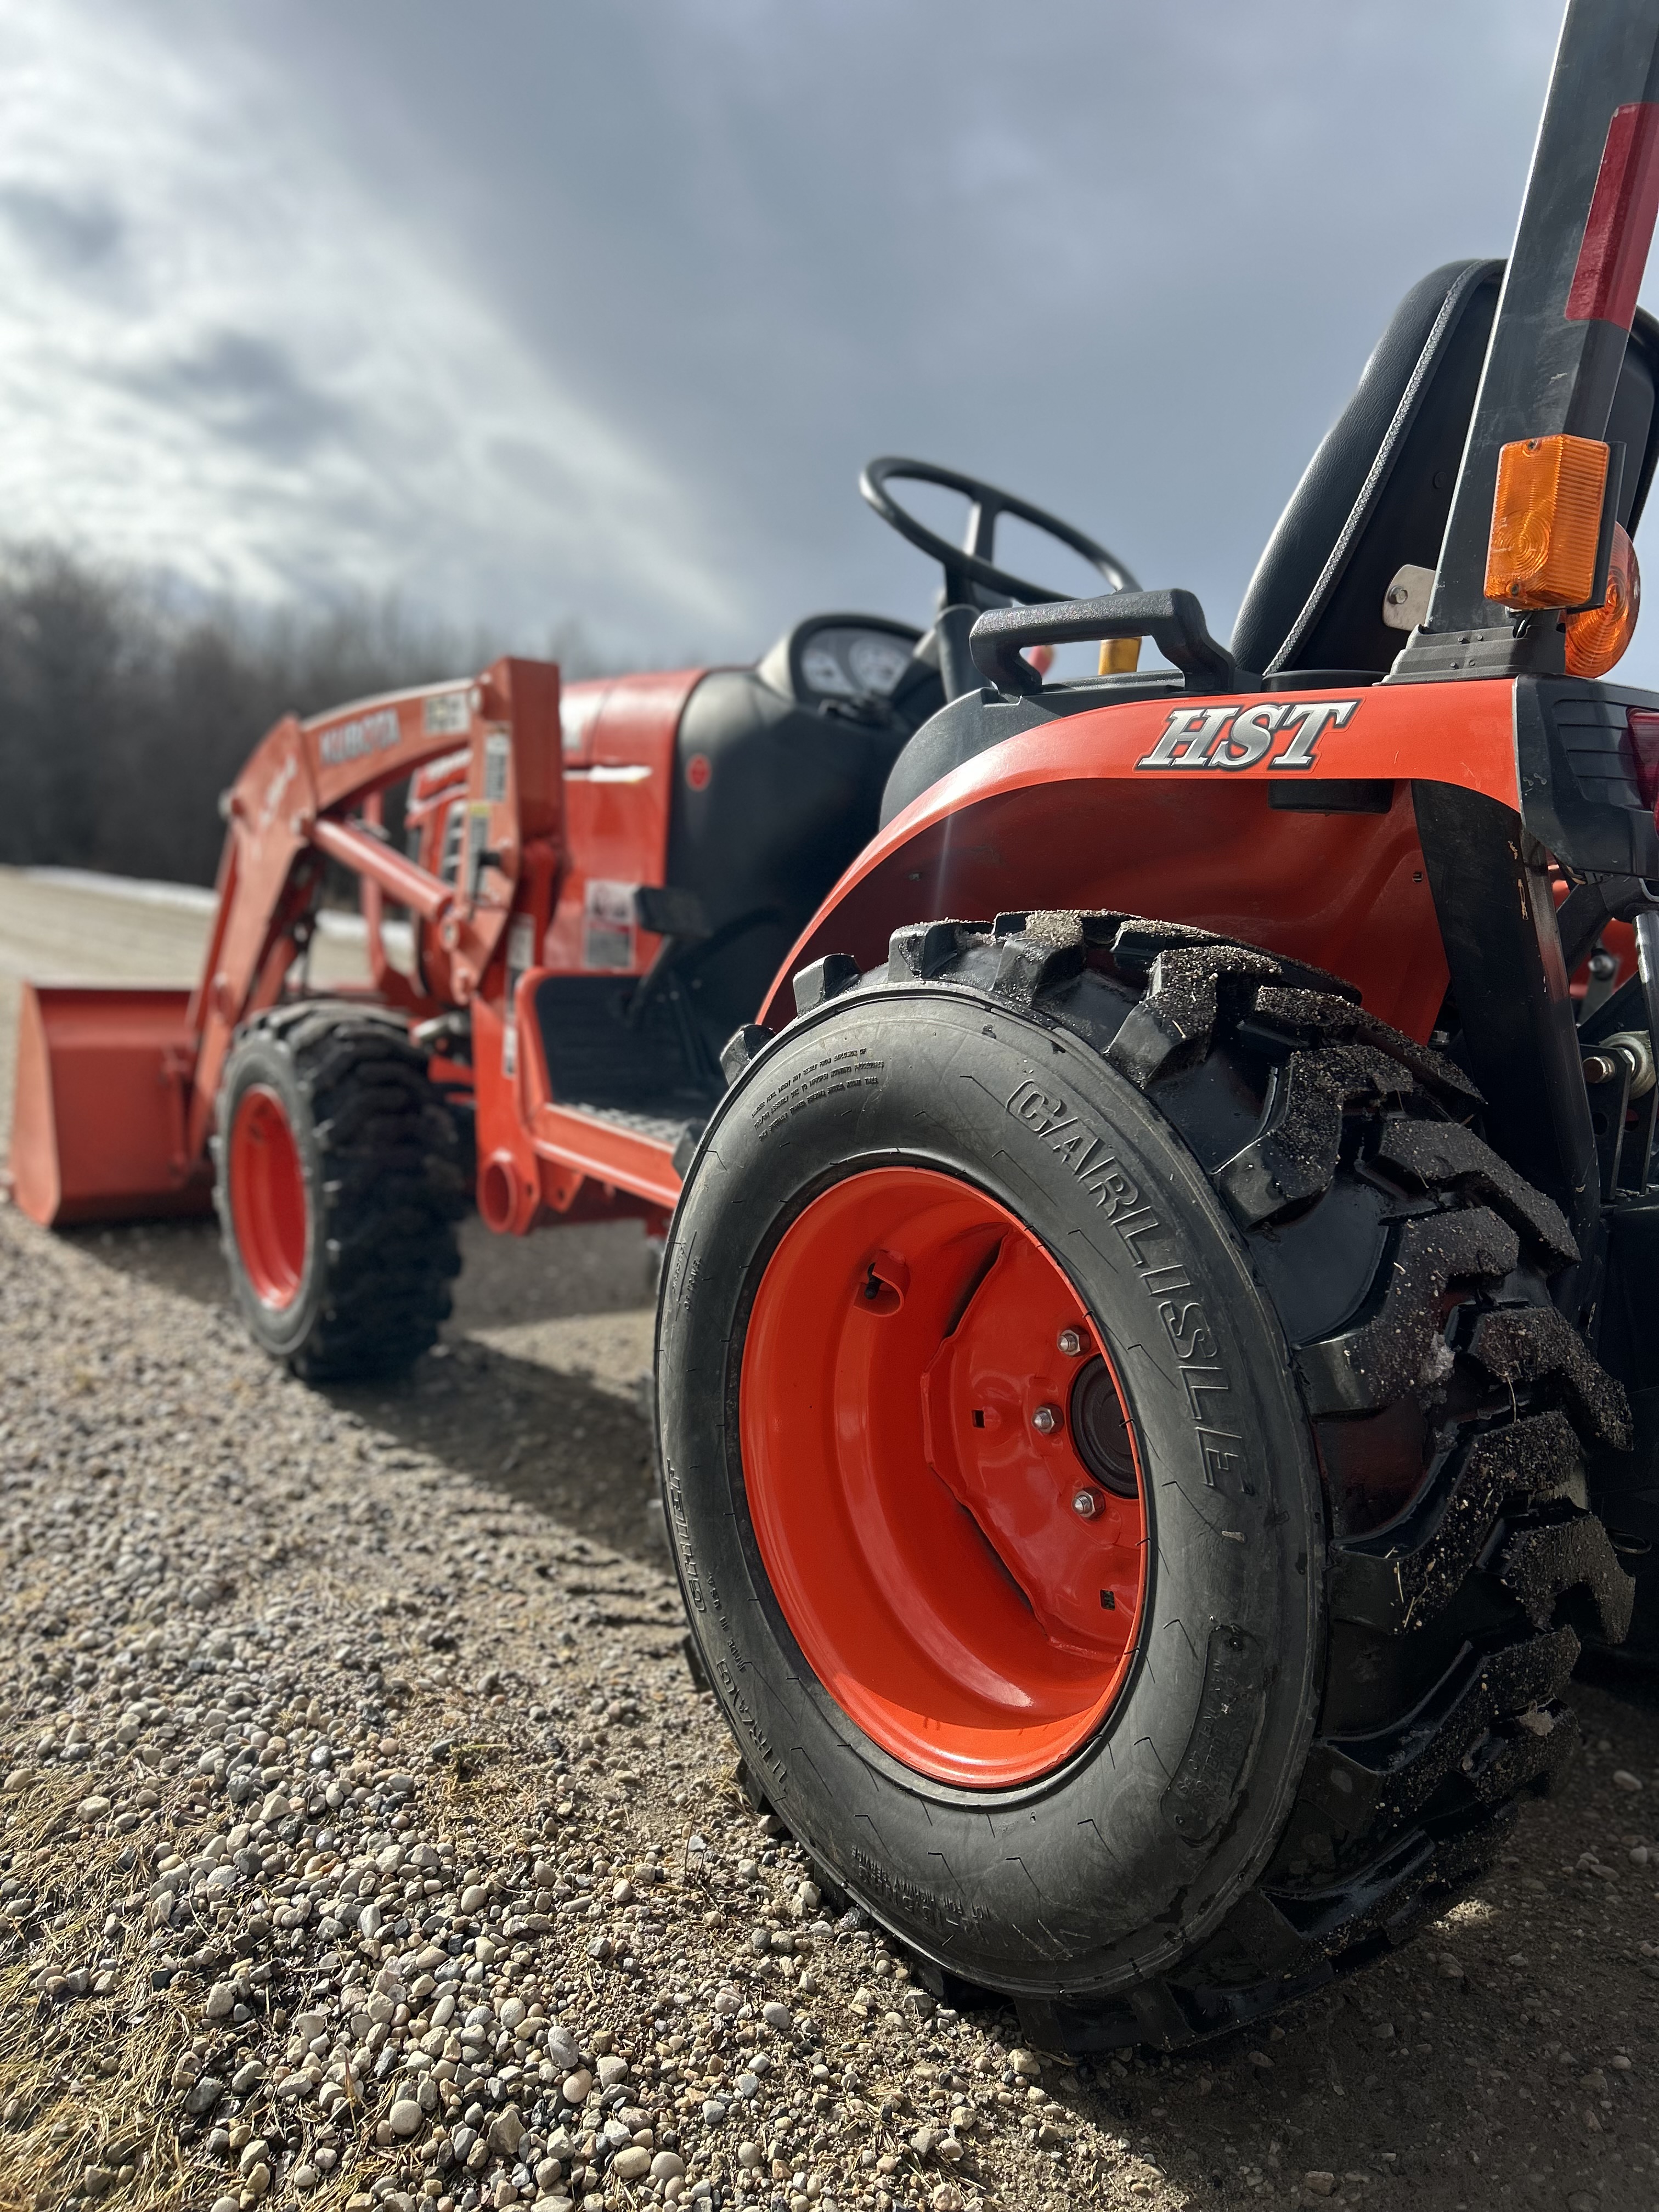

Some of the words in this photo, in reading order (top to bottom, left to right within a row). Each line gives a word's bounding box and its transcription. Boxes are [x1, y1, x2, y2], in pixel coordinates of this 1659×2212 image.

[1136, 699, 1359, 769] HST
[1006, 1079, 1246, 1492] CARLISLE
[666, 1457, 706, 1613] CHIEF
[719, 1616, 730, 1632] IN
[727, 1638, 747, 1674] MADE
